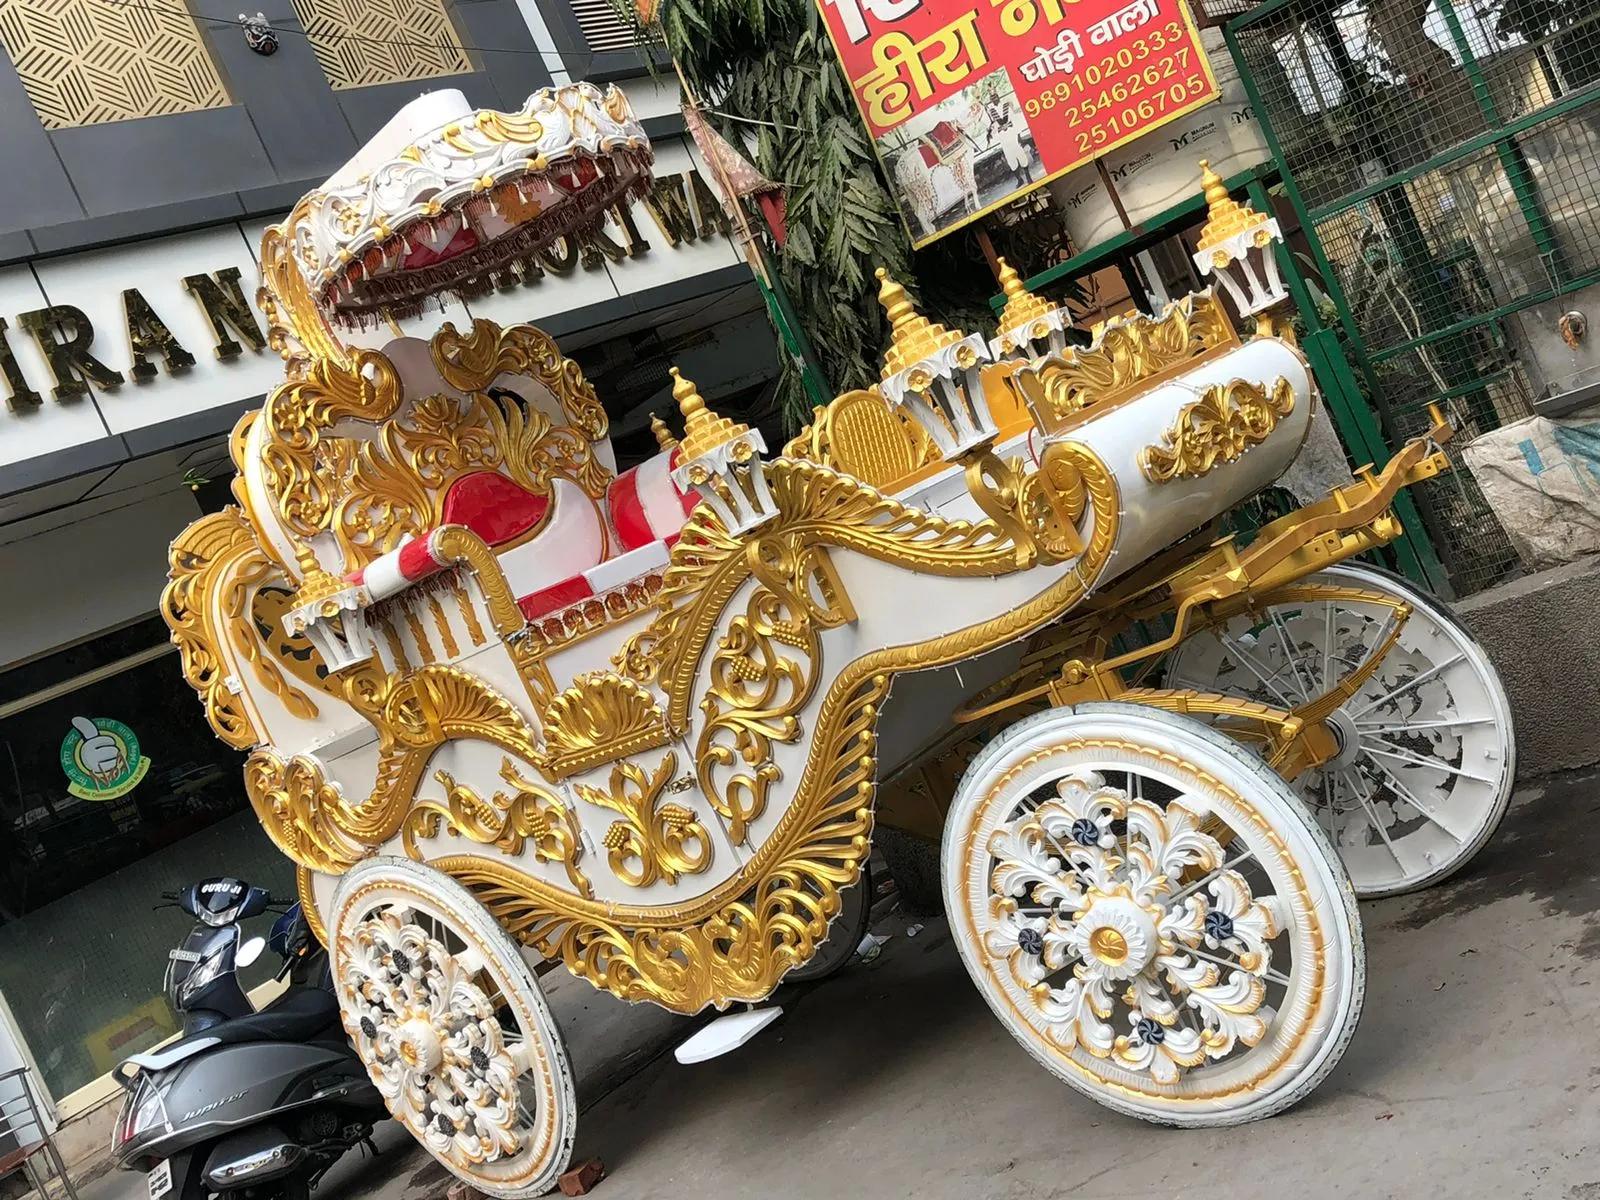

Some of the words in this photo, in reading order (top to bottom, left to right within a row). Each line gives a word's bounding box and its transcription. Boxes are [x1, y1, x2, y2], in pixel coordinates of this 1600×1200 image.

[853, 9, 989, 127] हीरा
[1019, 28, 1085, 82] घोड़ी
[1086, 0, 1160, 46] वाला
[1025, 21, 1183, 118] 9891020333
[1064, 46, 1190, 128] 25462627
[1074, 73, 1204, 154] 25106705
[201, 882, 231, 894] GURU
[230, 885, 242, 895] JI
